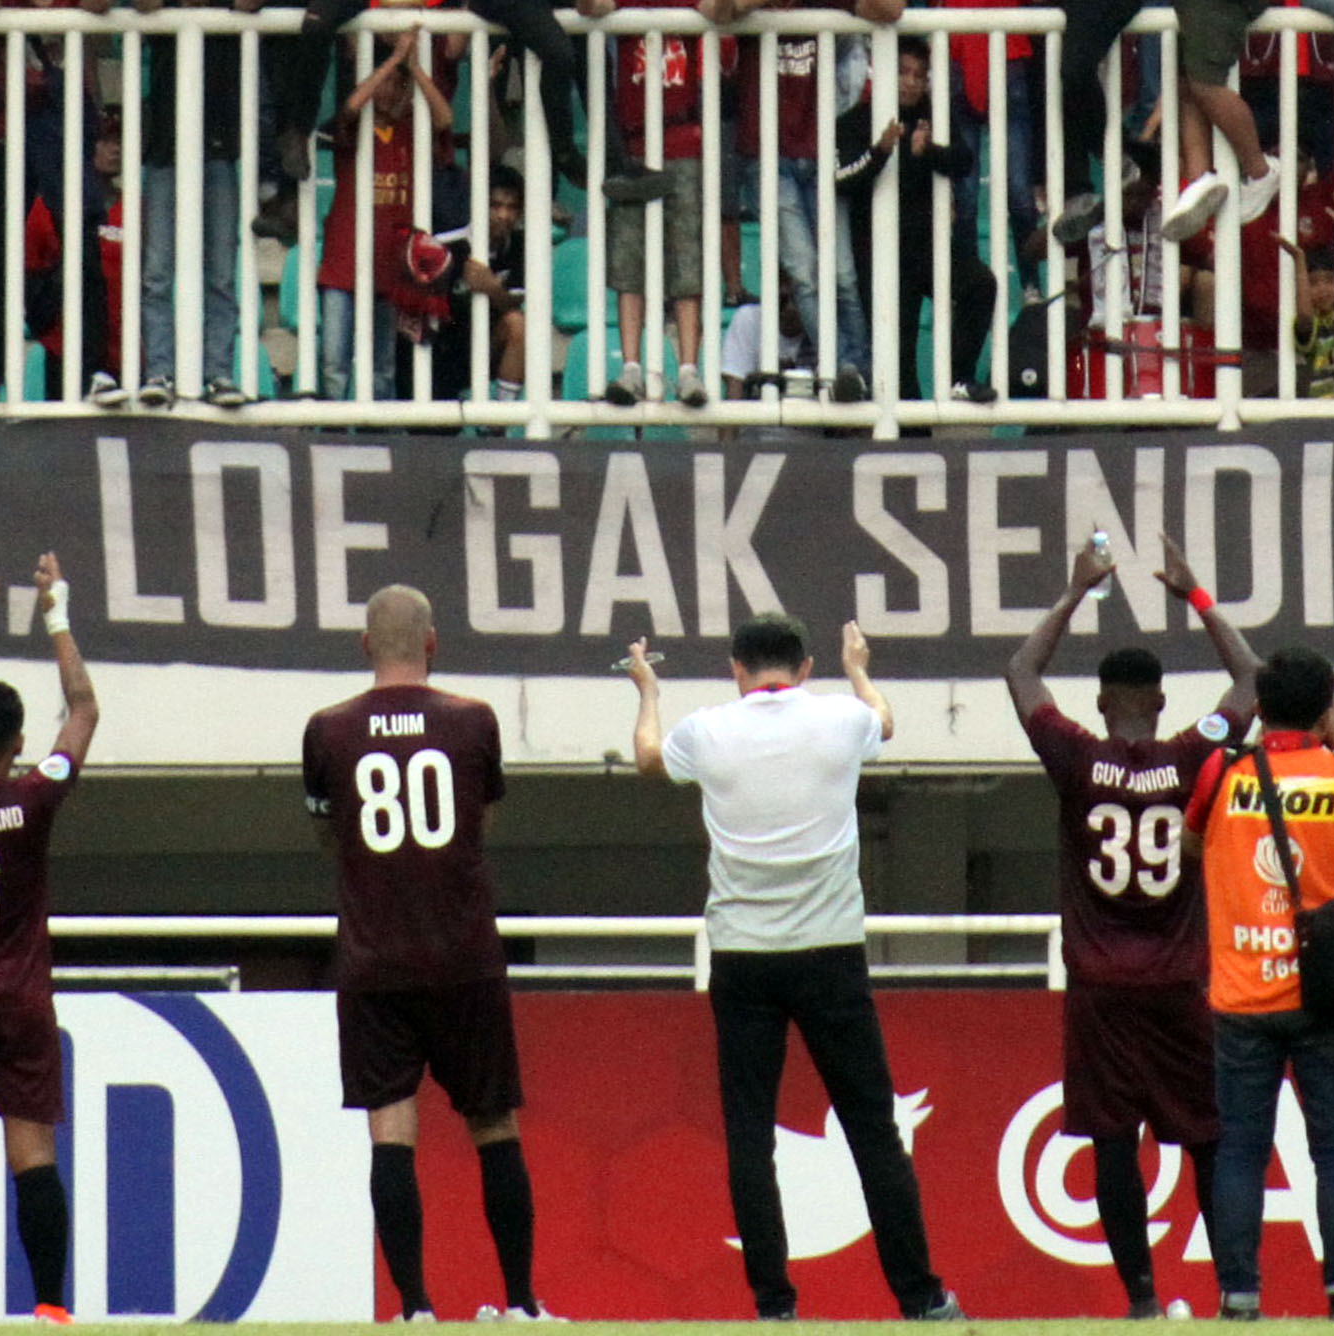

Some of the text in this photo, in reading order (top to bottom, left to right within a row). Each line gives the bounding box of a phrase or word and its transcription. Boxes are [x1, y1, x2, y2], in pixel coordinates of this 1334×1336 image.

[95, 436, 394, 632] LOE
[464, 449, 789, 640] GAK
[369, 712, 425, 737] PLUIM
[355, 748, 456, 853] 80
[1091, 760, 1126, 789] GUY
[1087, 802, 1184, 897] 39
[1234, 924, 1296, 953] PHO
